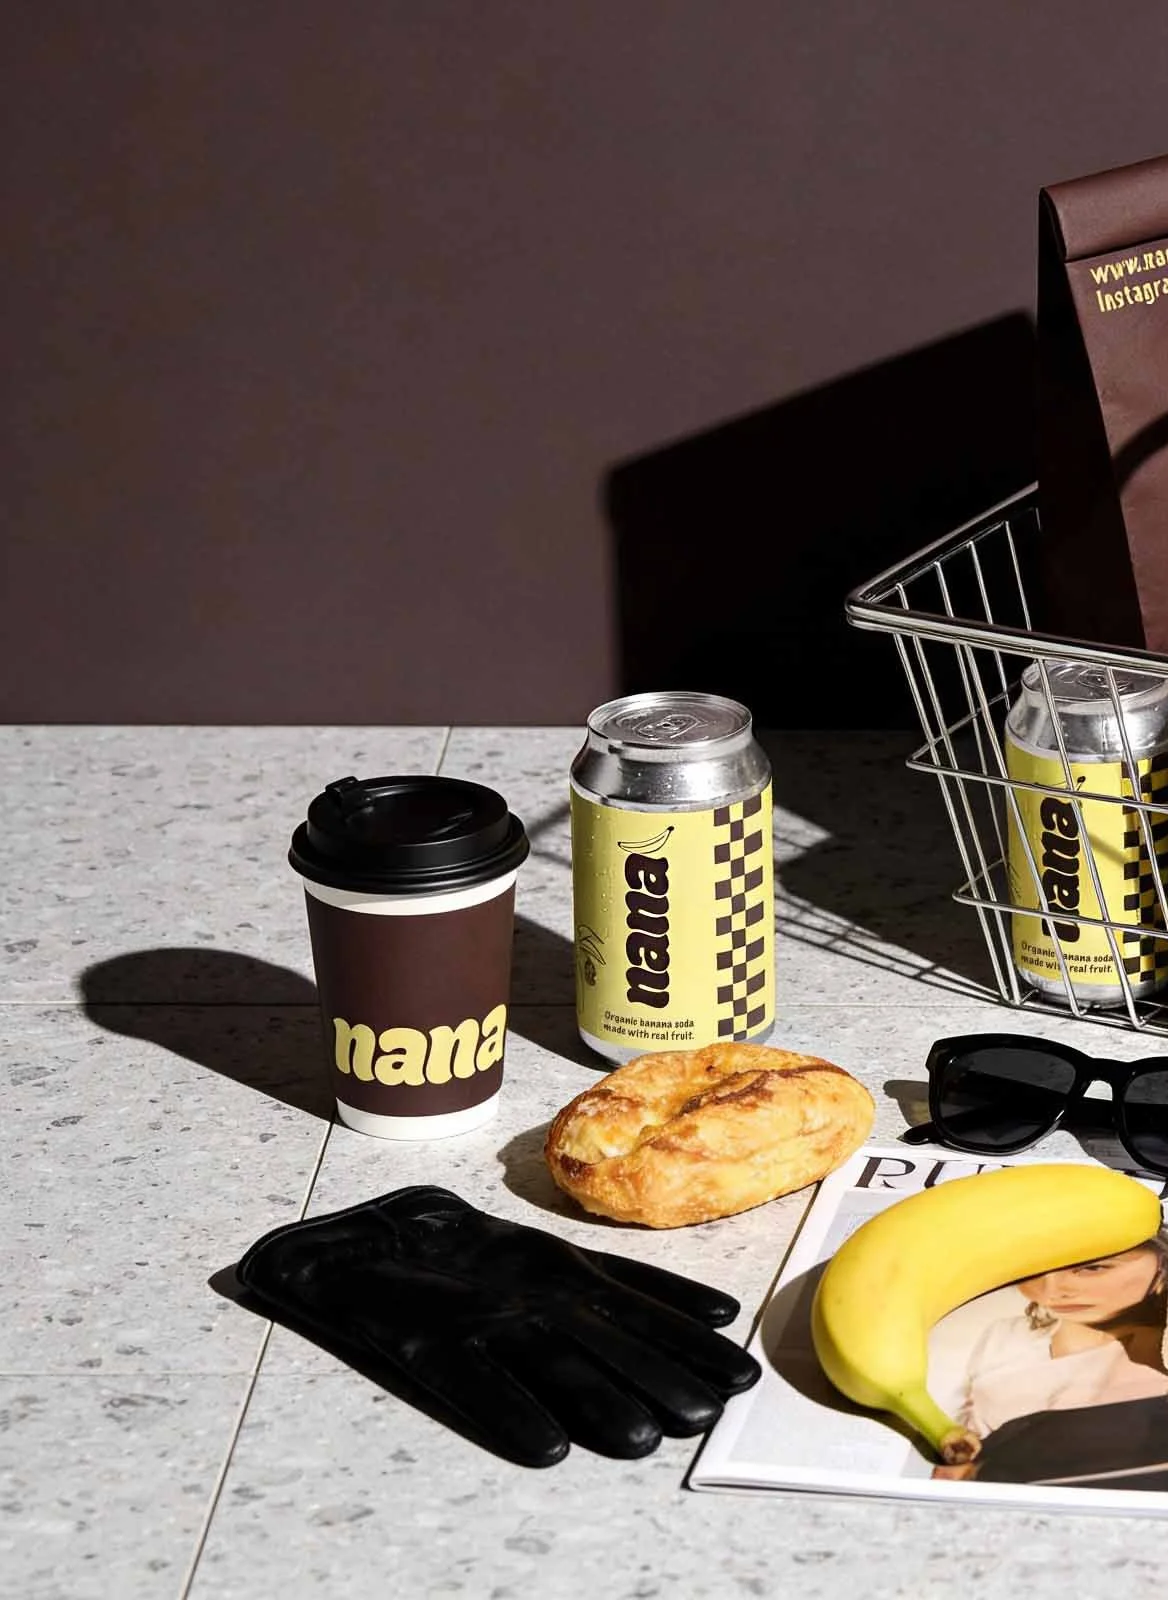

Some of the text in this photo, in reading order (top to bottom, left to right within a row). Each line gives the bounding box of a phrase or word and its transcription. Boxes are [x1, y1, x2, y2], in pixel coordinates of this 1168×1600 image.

[1040, 797, 1080, 943] nana
[626, 852, 671, 1009] nana
[1021, 941, 1055, 958] Organic
[1063, 952, 1091, 962] anana
[1021, 955, 1044, 967] made
[1069, 965, 1087, 973] real
[604, 1010, 695, 1029] Organic banana soda
[603, 1023, 695, 1041] made with real fruit.
[333, 1004, 508, 1087] nana
